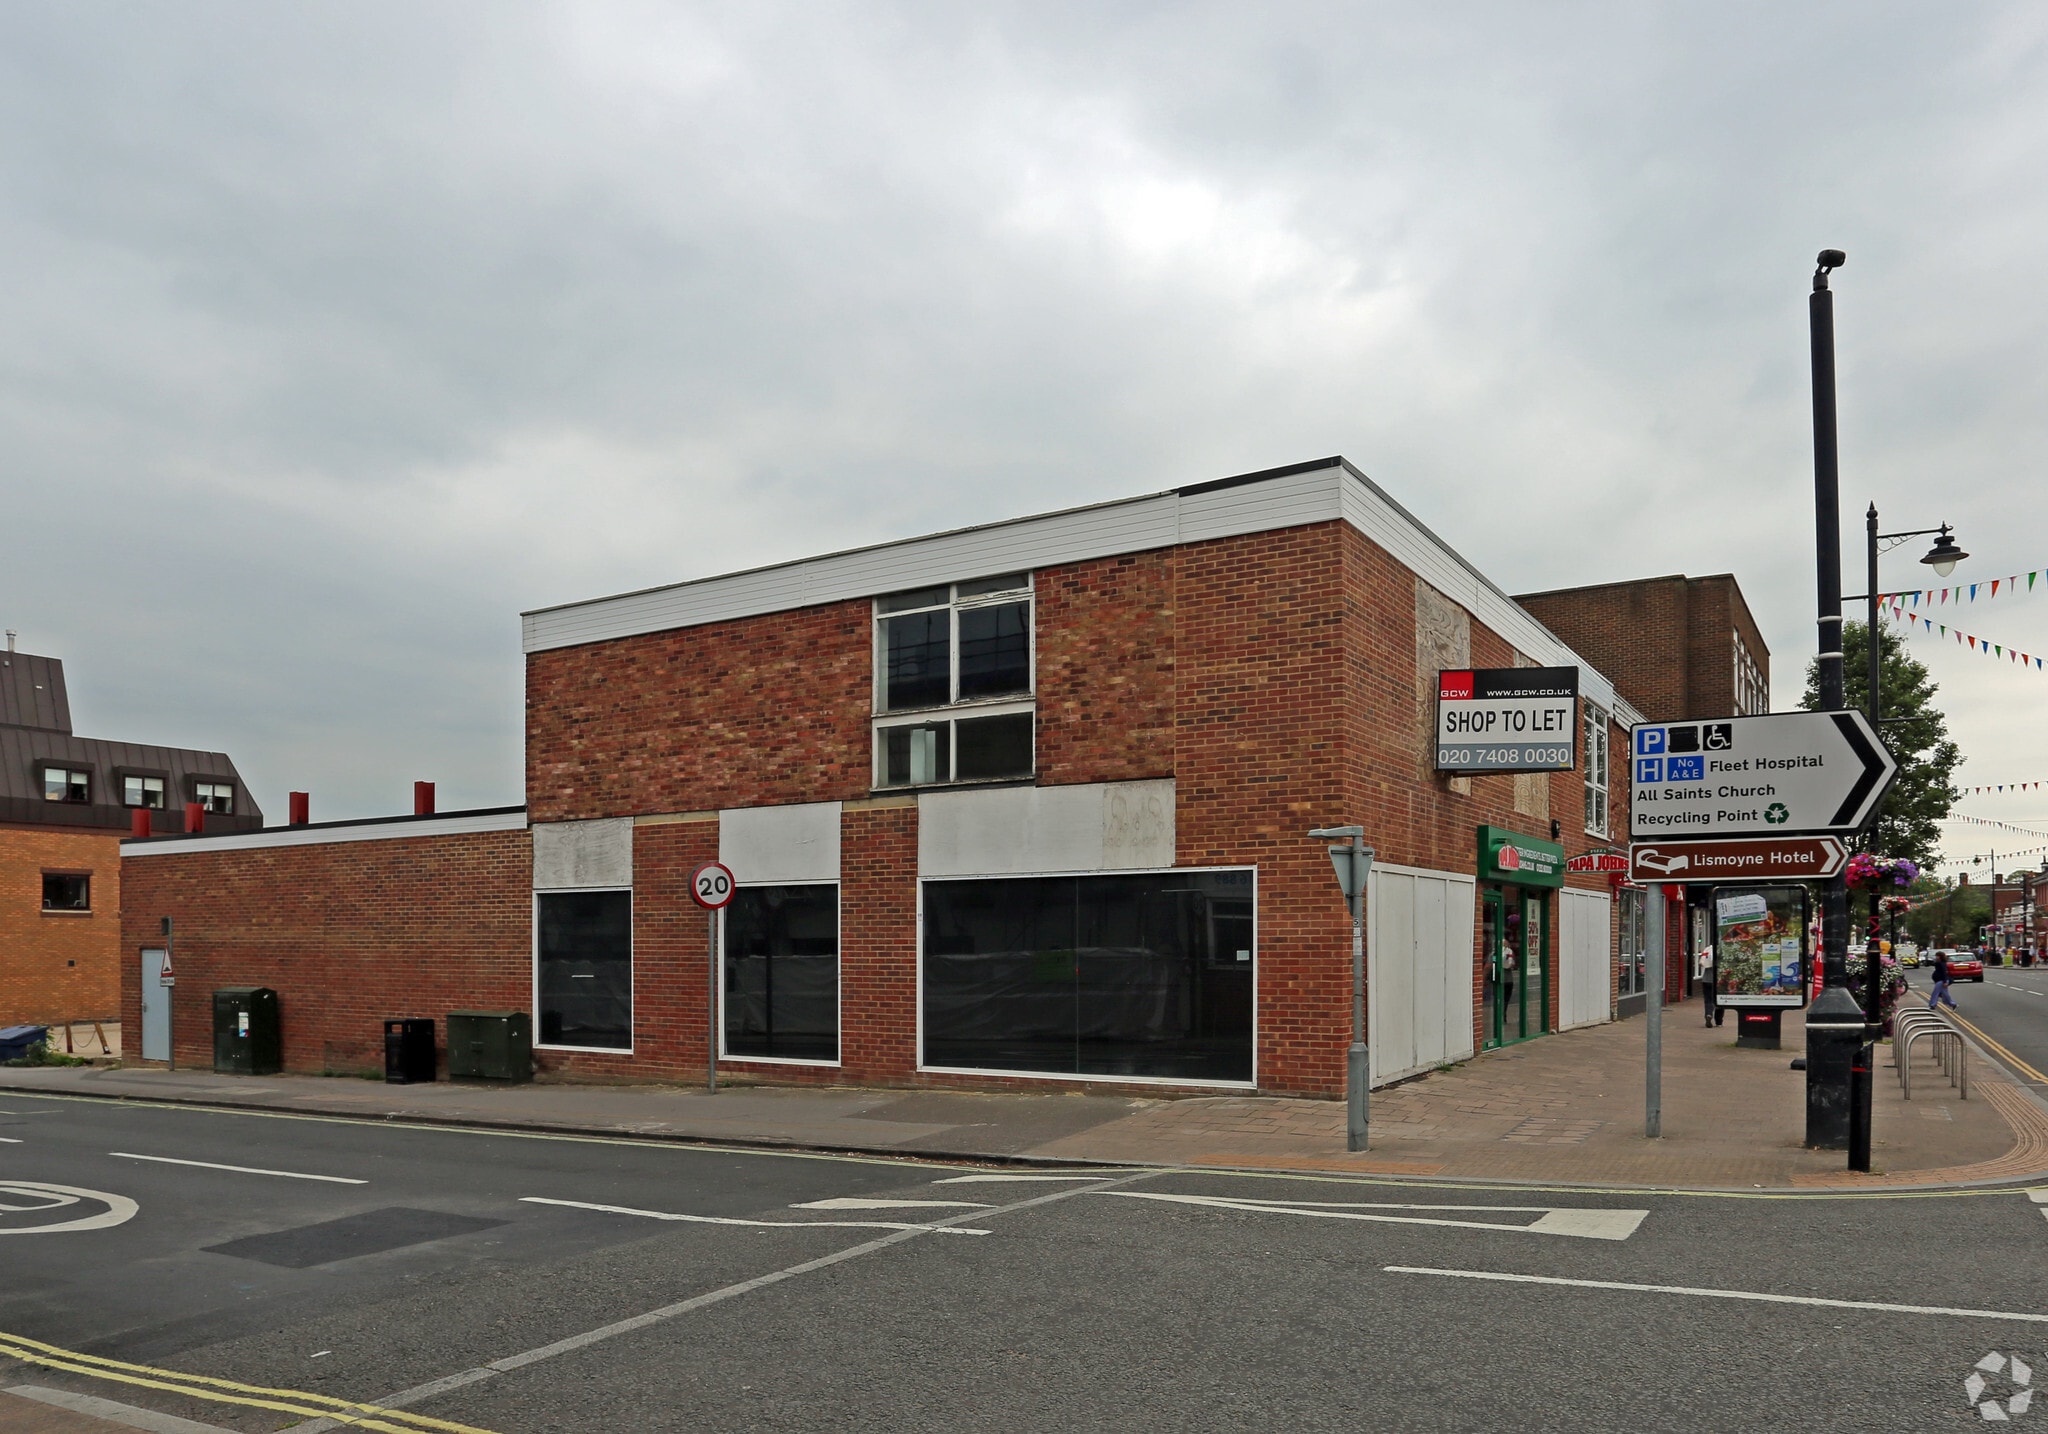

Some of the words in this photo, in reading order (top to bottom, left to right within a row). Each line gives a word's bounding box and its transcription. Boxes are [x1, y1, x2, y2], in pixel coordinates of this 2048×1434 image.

[1440, 689, 1469, 698] GCW
[1446, 710, 1497, 733] SHOP
[1502, 709, 1526, 732] TO
[1532, 709, 1567, 731] LET
[1643, 731, 1662, 753] P
[1438, 749, 1471, 764] 020
[1476, 749, 1519, 764] 7408
[1524, 748, 1569, 763] 0030
[1677, 758, 1695, 768] No
[1710, 759, 1749, 773] Fleet
[1756, 754, 1824, 771] Hospital
[1640, 759, 1660, 781] H
[1637, 789, 1658, 802] All
[1663, 787, 1712, 801] Saints
[1717, 784, 1776, 798] Church
[1637, 811, 1711, 826] Recycling
[1717, 809, 1758, 822] Point
[1568, 855, 1595, 871] PAPA
[1694, 854, 1764, 867] Lismoyne
[1770, 850, 1816, 864] Hotel
[698, 875, 729, 897] 20
